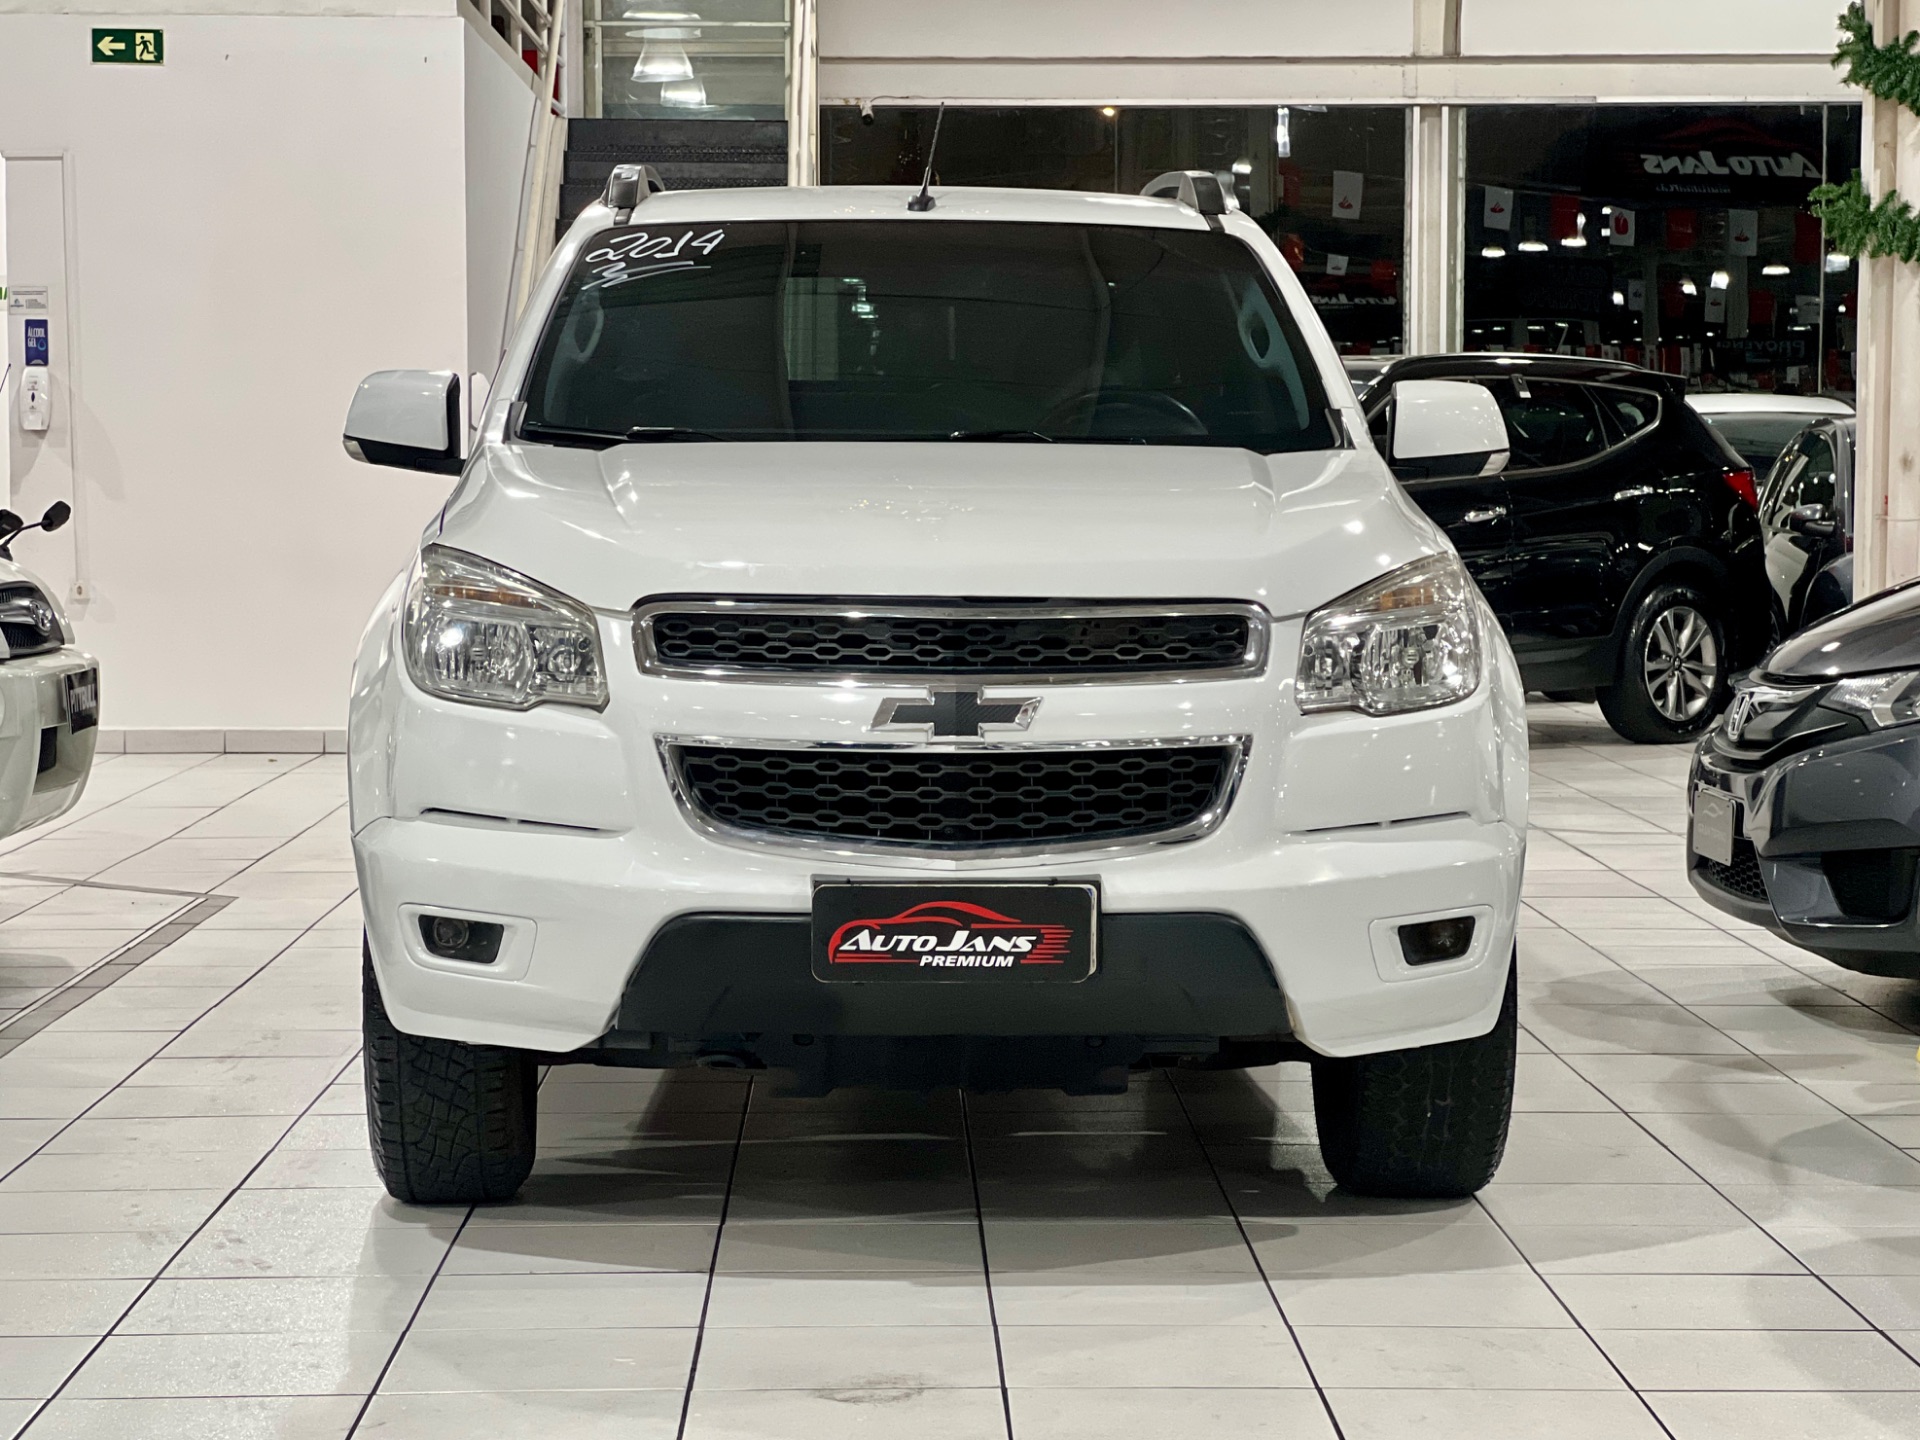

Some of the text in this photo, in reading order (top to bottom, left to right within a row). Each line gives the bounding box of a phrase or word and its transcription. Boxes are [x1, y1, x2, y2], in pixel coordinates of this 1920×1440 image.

[585, 229, 725, 262] 2014
[27, 337, 37, 348] GEL
[70, 683, 97, 714] PITTBULL
[839, 928, 1037, 952] AUTO JANS
[919, 955, 1015, 968] PREMIUM
